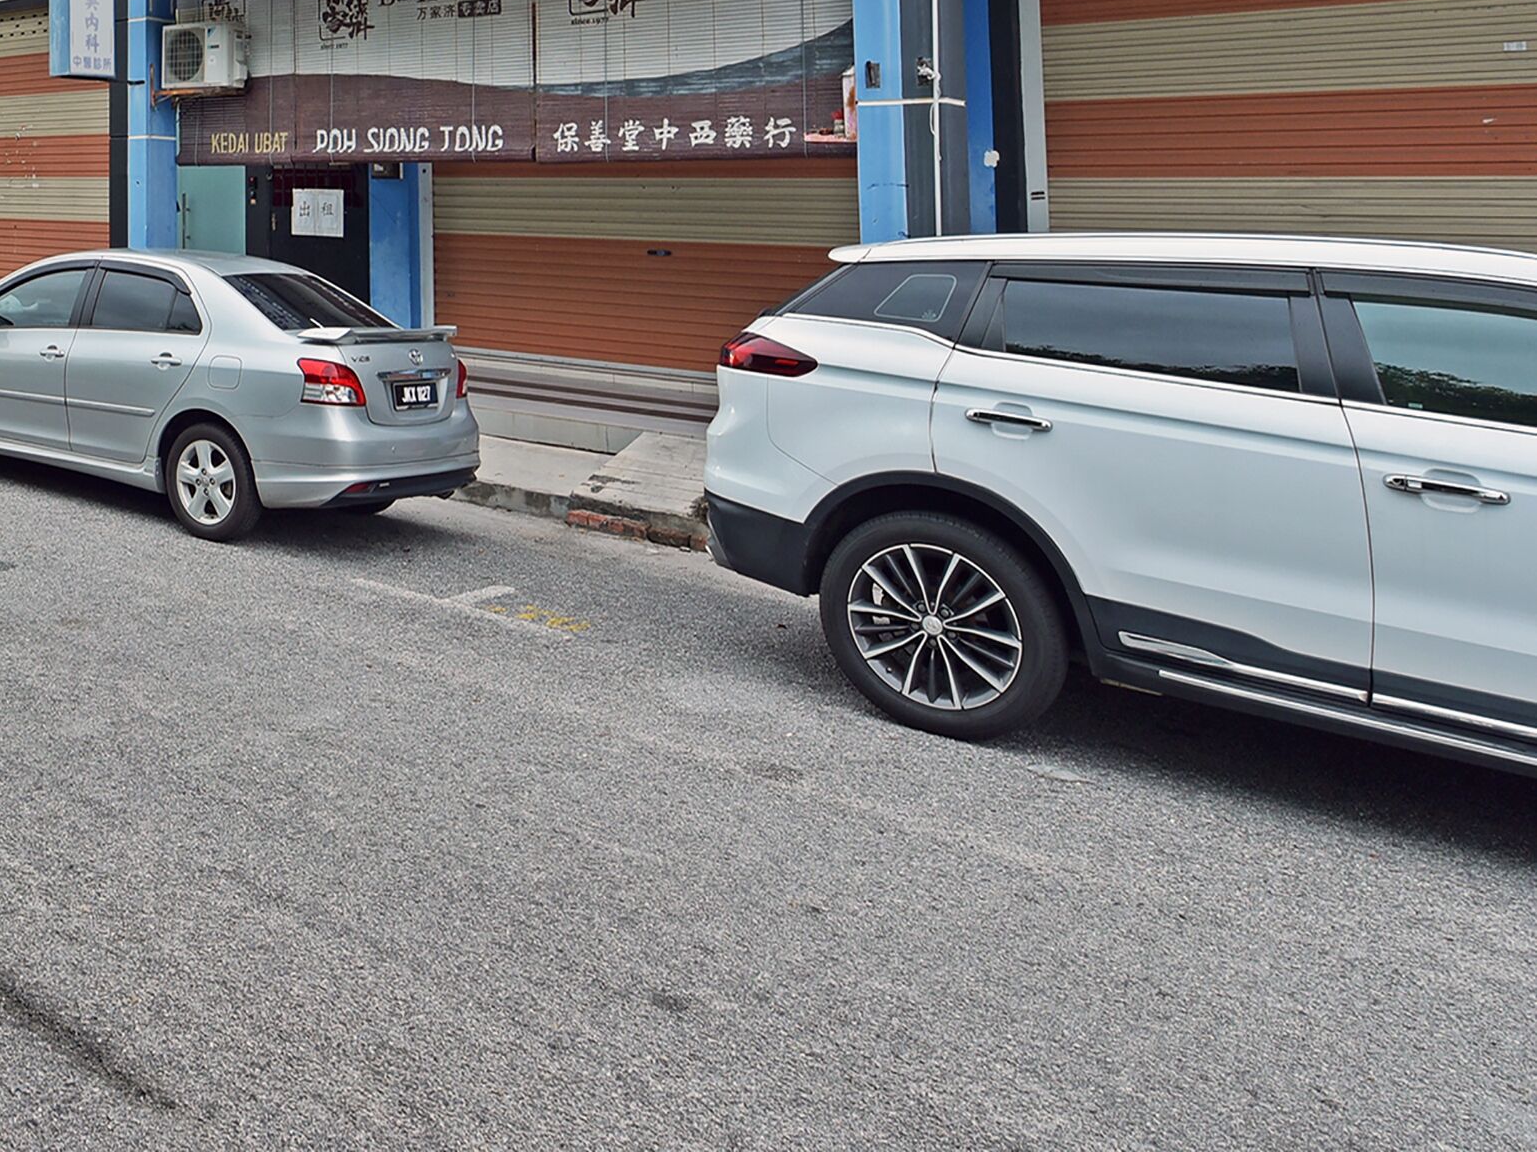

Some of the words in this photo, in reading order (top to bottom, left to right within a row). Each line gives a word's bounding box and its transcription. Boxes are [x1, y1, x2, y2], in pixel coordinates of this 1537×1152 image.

[416, 5, 456, 21] 万家济
[211, 132, 250, 154] KEDAI
[254, 131, 289, 153] UBAT
[313, 128, 357, 153] POH
[363, 126, 430, 154] SIONG
[439, 124, 504, 153] TONG
[553, 116, 797, 153] 保善堂中西藥行
